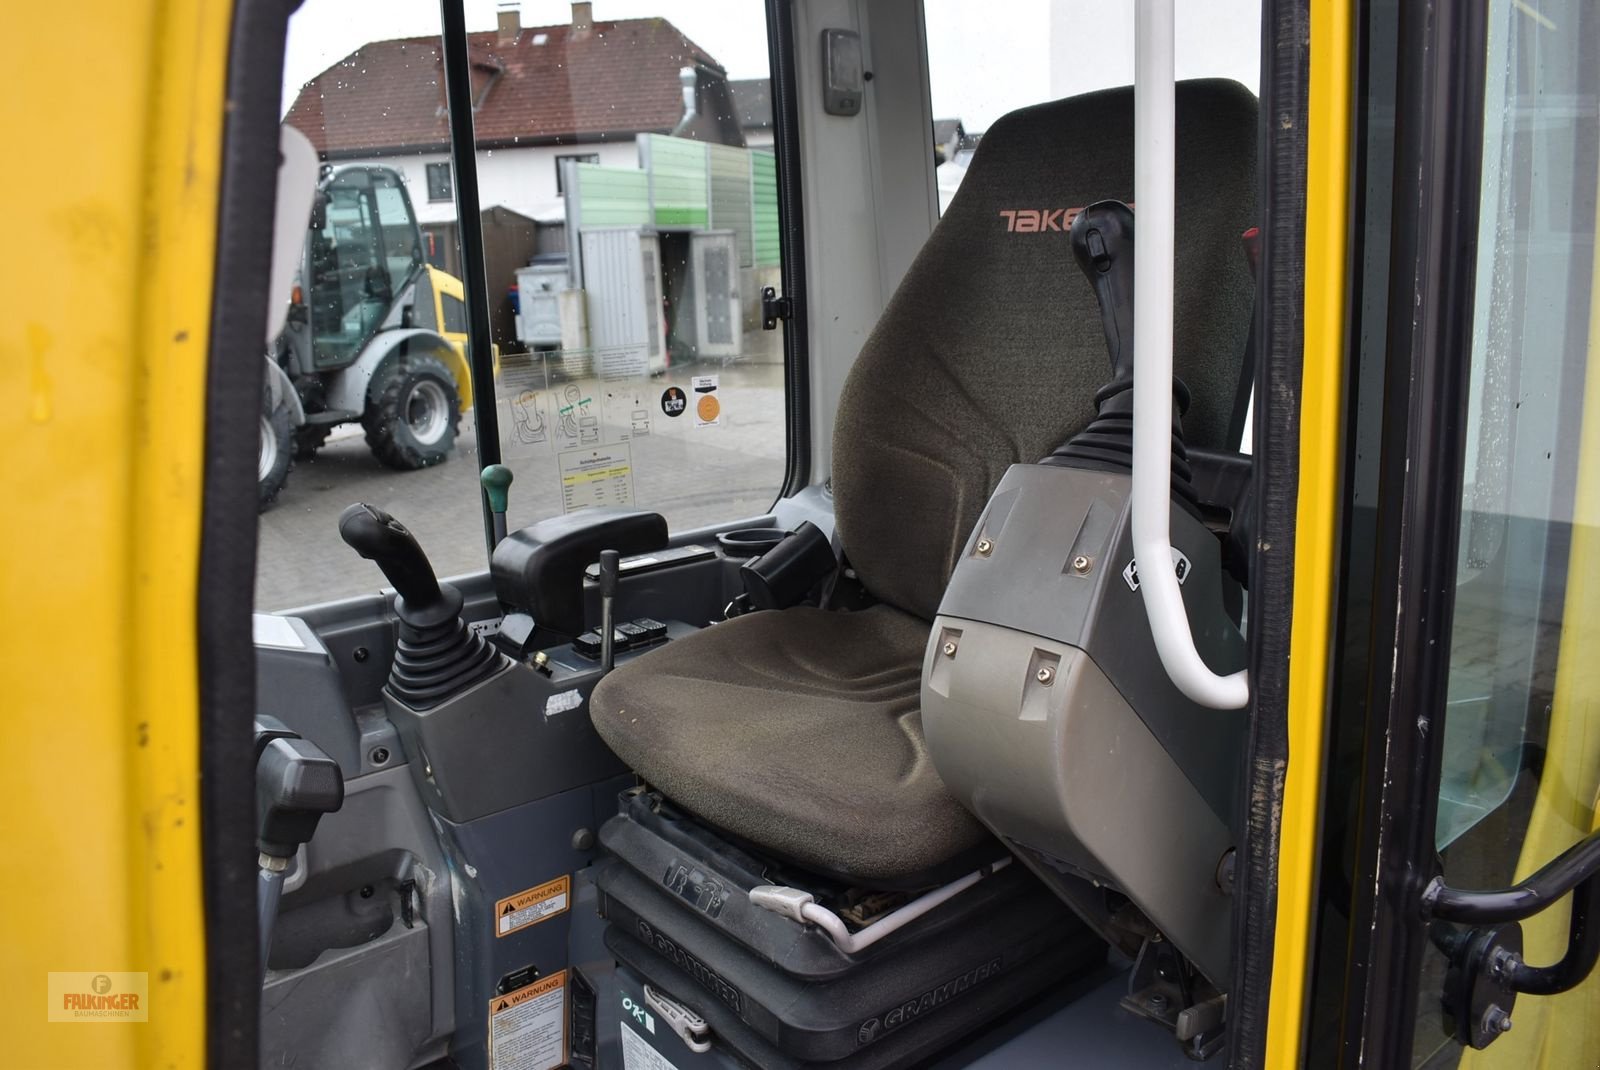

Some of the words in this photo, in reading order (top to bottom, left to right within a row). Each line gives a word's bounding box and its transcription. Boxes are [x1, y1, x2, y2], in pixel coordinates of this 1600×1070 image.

[999, 207, 1084, 232] TAKE
[516, 883, 563, 907] WARNUNG
[511, 979, 559, 1005] WARNUNG
[884, 956, 1002, 1030] GRAMMER
